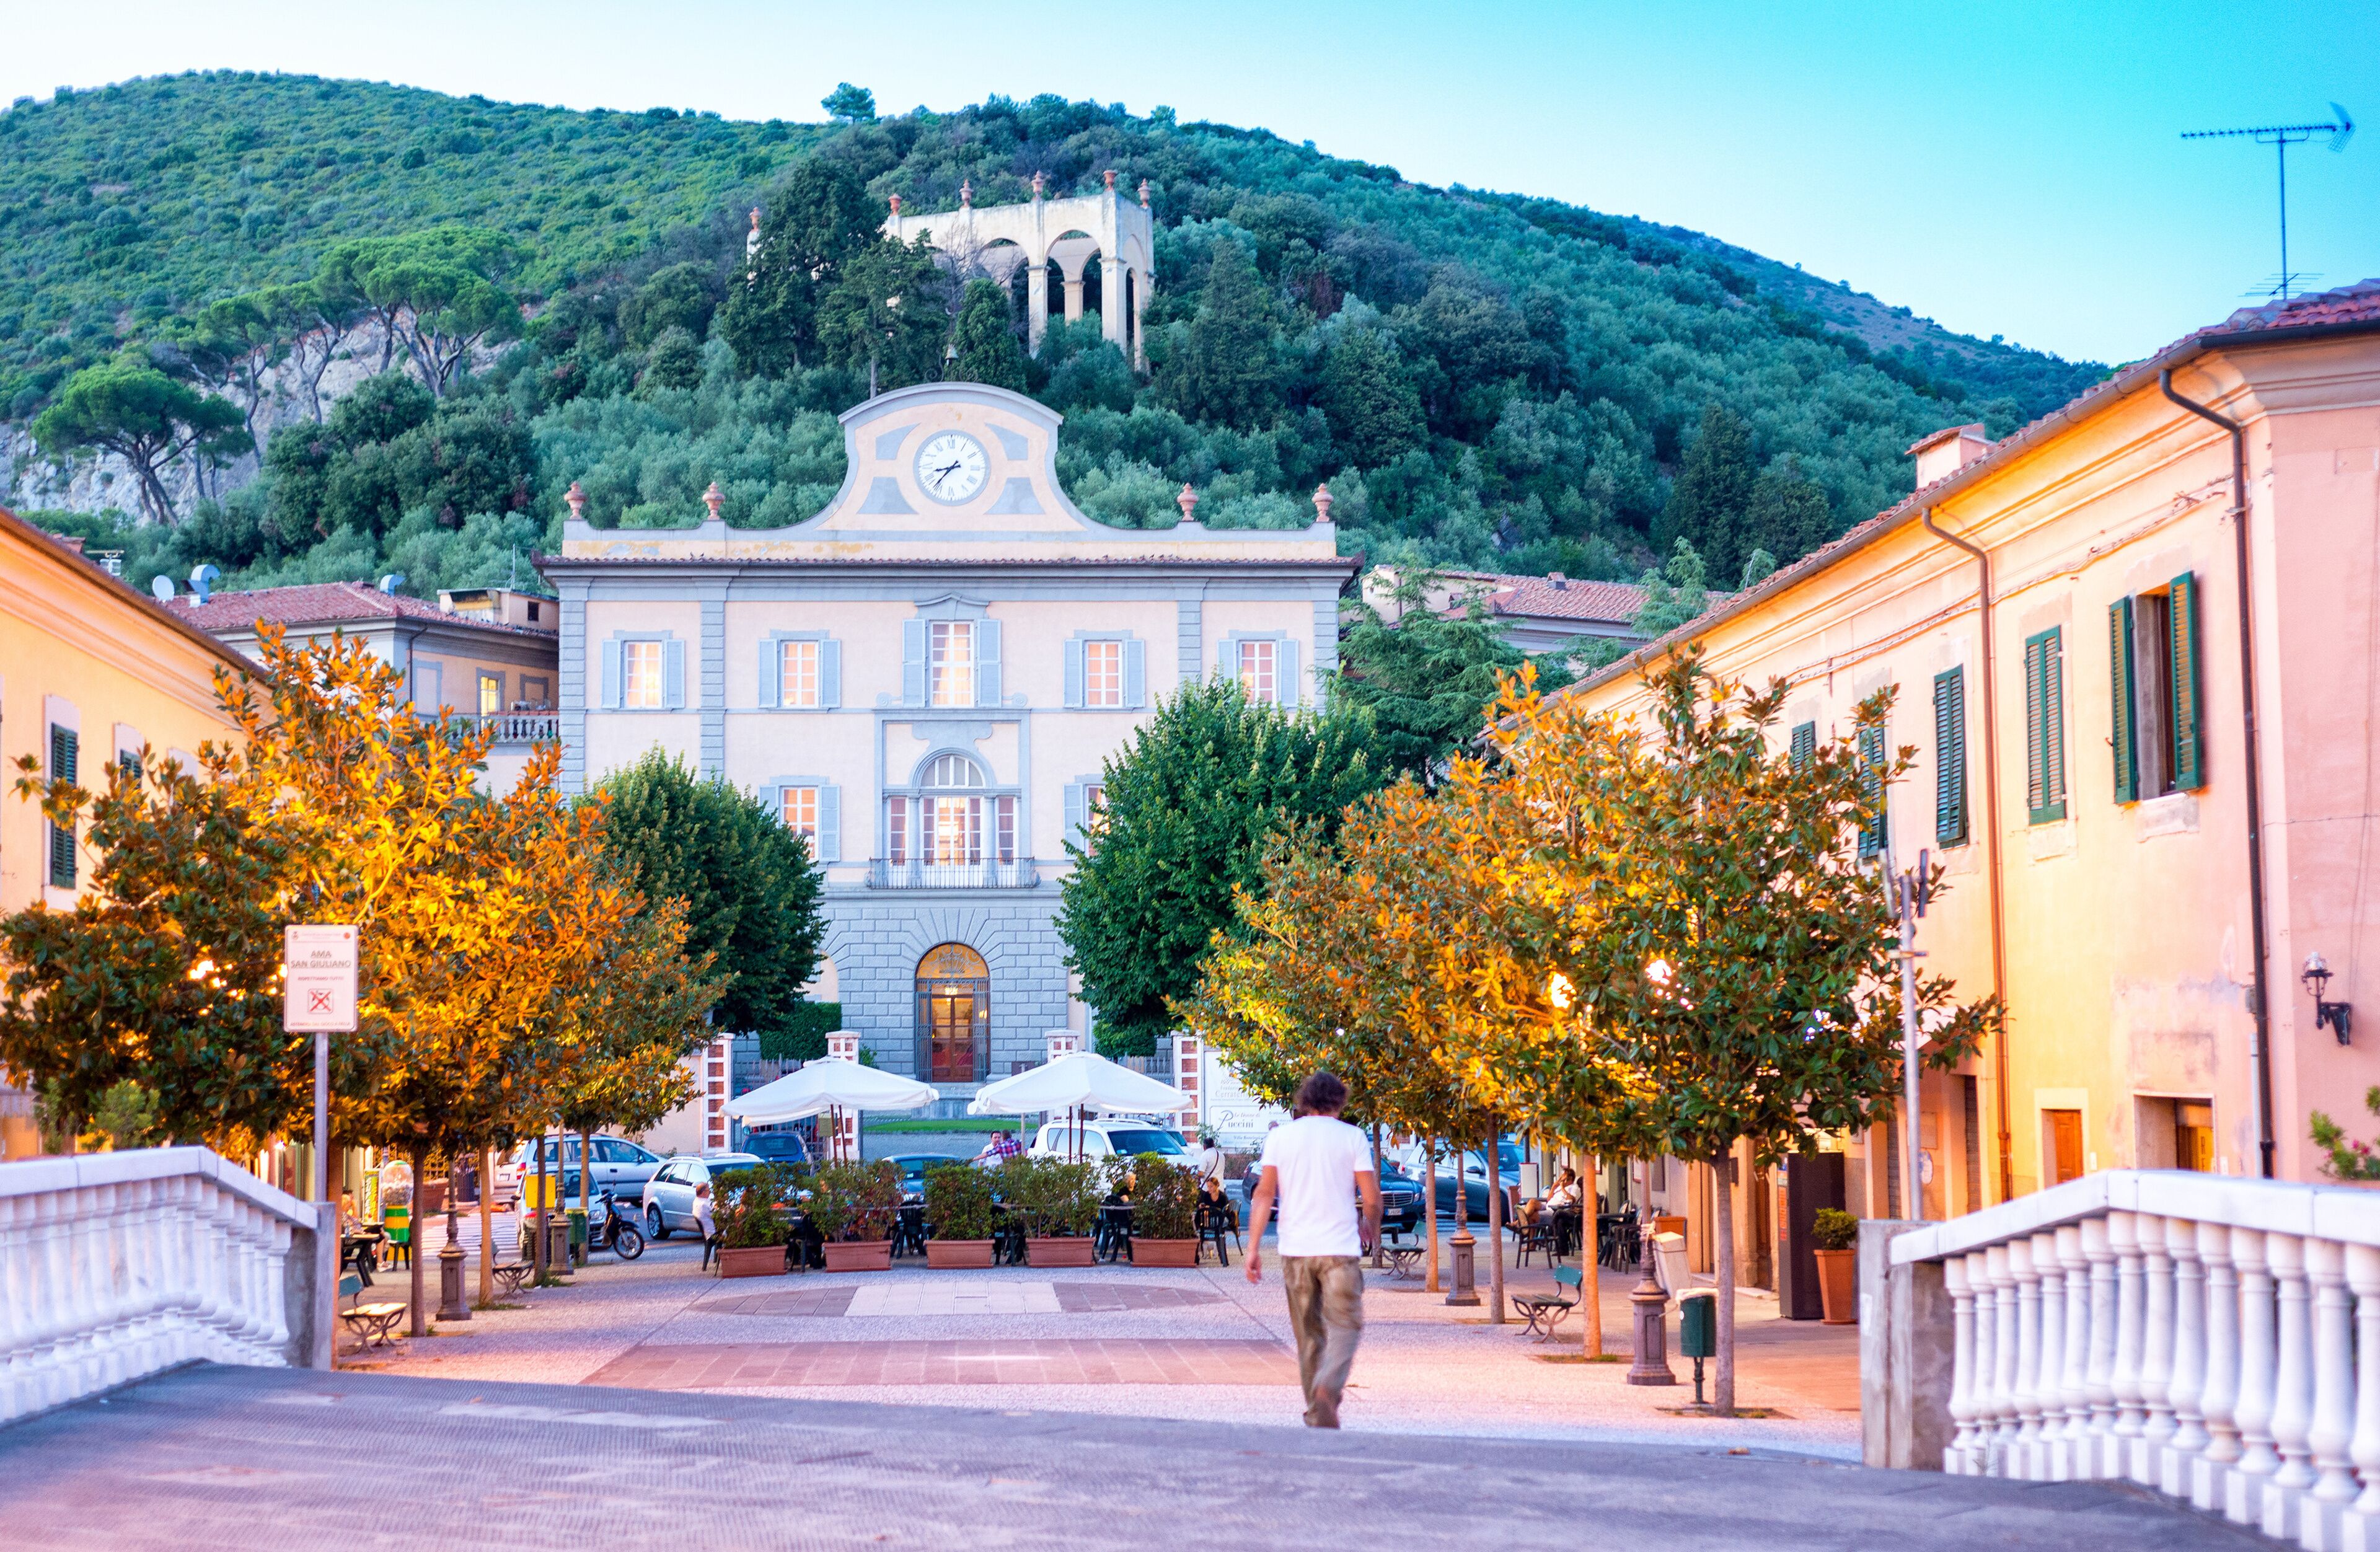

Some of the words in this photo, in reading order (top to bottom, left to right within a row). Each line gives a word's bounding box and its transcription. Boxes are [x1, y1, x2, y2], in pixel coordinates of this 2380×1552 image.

[311, 950, 332, 959] AMA
[291, 960, 308, 968] SAN
[310, 960, 351, 968] GIULIANO
[1219, 1109, 1253, 1131] Puccini
